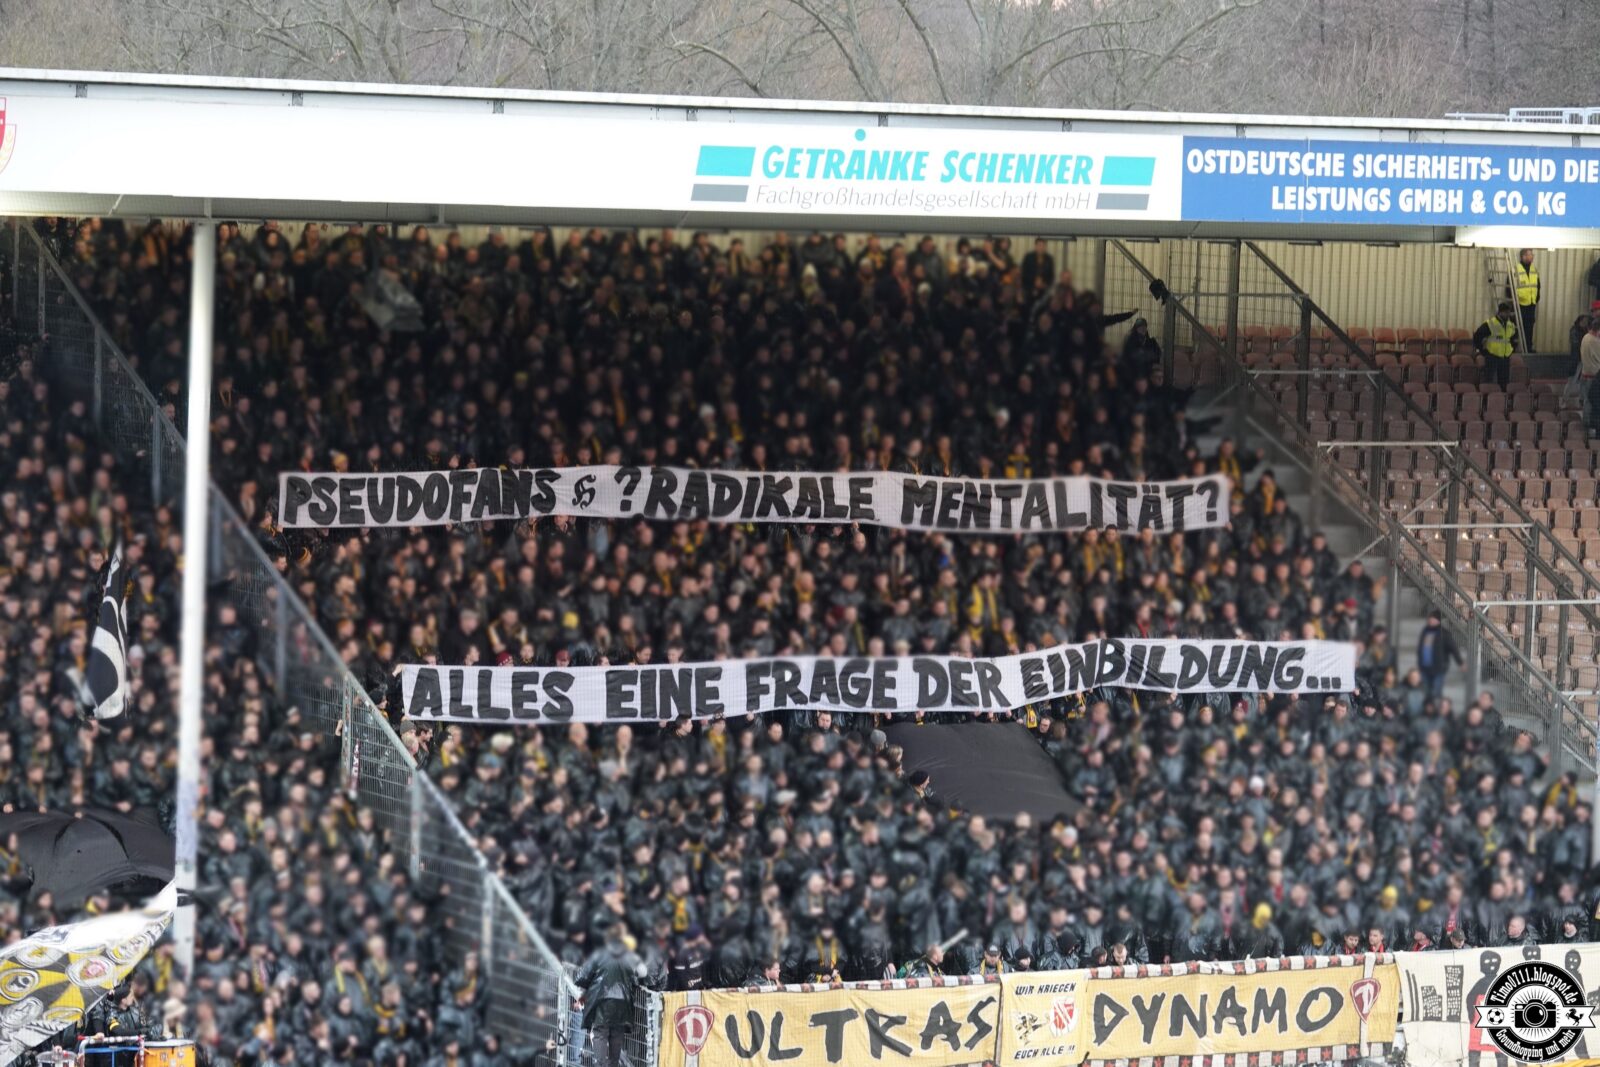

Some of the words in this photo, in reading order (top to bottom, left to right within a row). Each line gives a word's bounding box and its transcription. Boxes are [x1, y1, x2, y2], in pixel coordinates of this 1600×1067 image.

[939, 150, 1094, 185] SCHENKER
[1186, 148, 1345, 177] OSTDEUTSCHE
[1353, 153, 1501, 181] SICHERHEITS-
[1508, 158, 1557, 182] UND
[1563, 159, 1599, 183] DIE
[756, 184, 1039, 212] Fachgroßhandelsgesellschaft
[1045, 191, 1091, 210] mbH
[1271, 186, 1391, 212] LEISTUNGS
[1399, 189, 1464, 214] GMBH
[1471, 190, 1487, 214] &
[1493, 190, 1529, 215] CO.
[1537, 191, 1567, 216] KG
[283, 467, 562, 526] PSEUDOFANS
[901, 478, 1220, 531] MENTALITÄT?
[408, 667, 575, 721] ALLES
[606, 667, 725, 719] EINE
[745, 659, 899, 710] FRAGE
[912, 657, 1011, 708] DER
[1019, 638, 1342, 699] EINBILDUNG...
[1015, 984, 1035, 996] WIR
[1037, 982, 1077, 994] KRIEGEN
[724, 996, 997, 1064] ULTRAS
[1093, 986, 1344, 1047] DYNAMO
[1014, 1048, 1040, 1060] EUCH
[1040, 1045, 1064, 1056] ALLE
